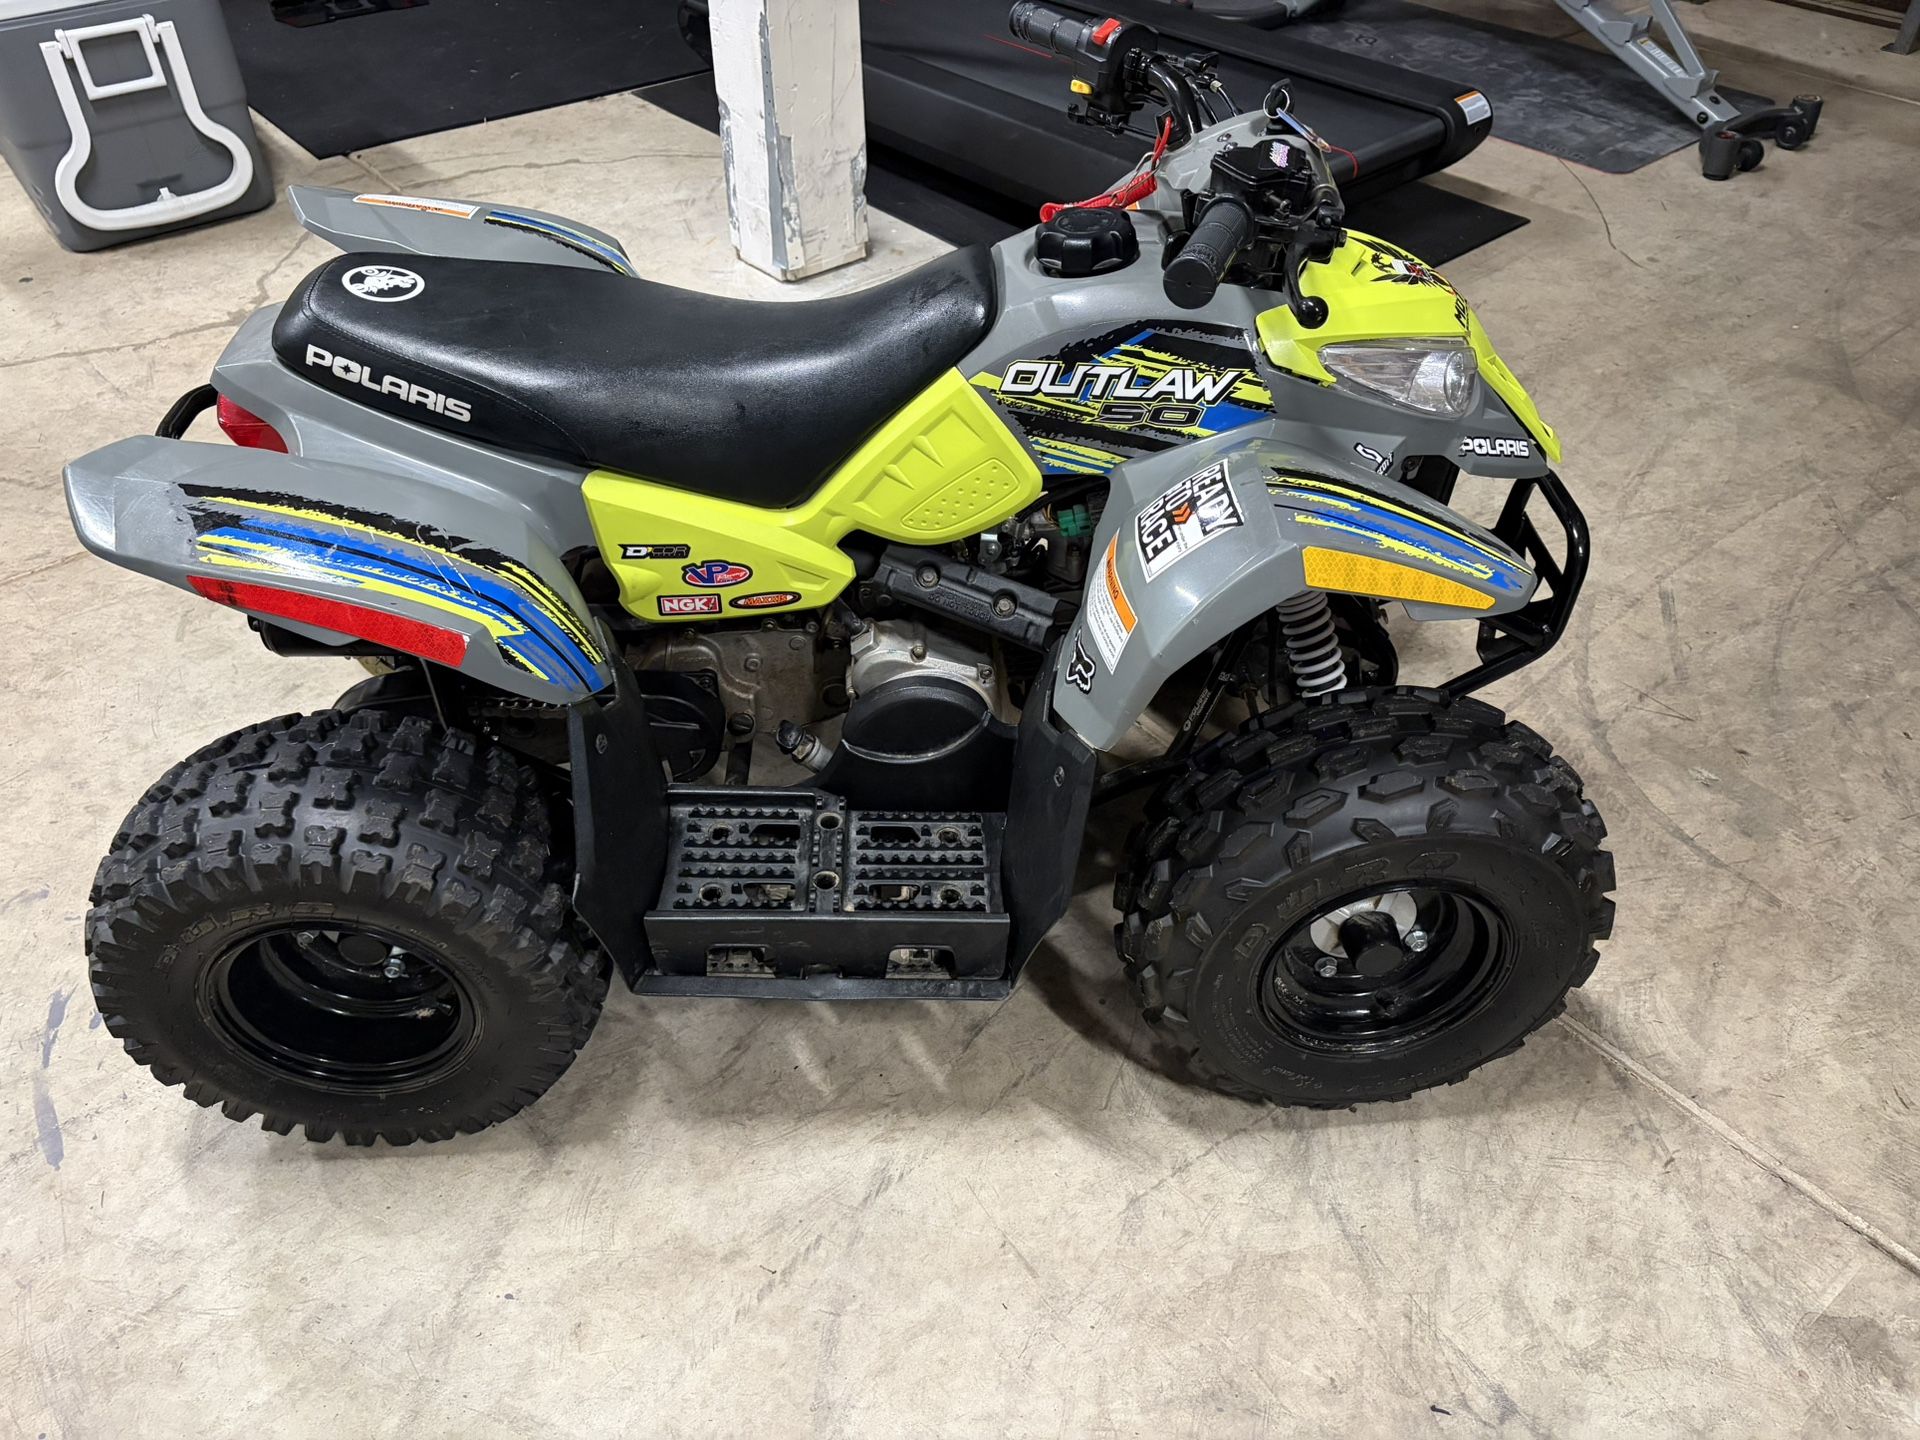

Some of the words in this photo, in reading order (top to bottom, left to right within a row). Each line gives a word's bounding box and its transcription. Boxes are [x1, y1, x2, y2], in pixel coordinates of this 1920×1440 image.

[305, 343, 471, 423] POLARIS
[999, 361, 1243, 405] OUTLAW
[1097, 403, 1206, 427] 50
[1460, 437, 1530, 457] POLARIS
[1165, 480, 1192, 511] TO
[1192, 464, 1238, 532] READY
[1140, 496, 1174, 559] RACE
[687, 562, 729, 584] VP
[664, 598, 709, 612] NGK
